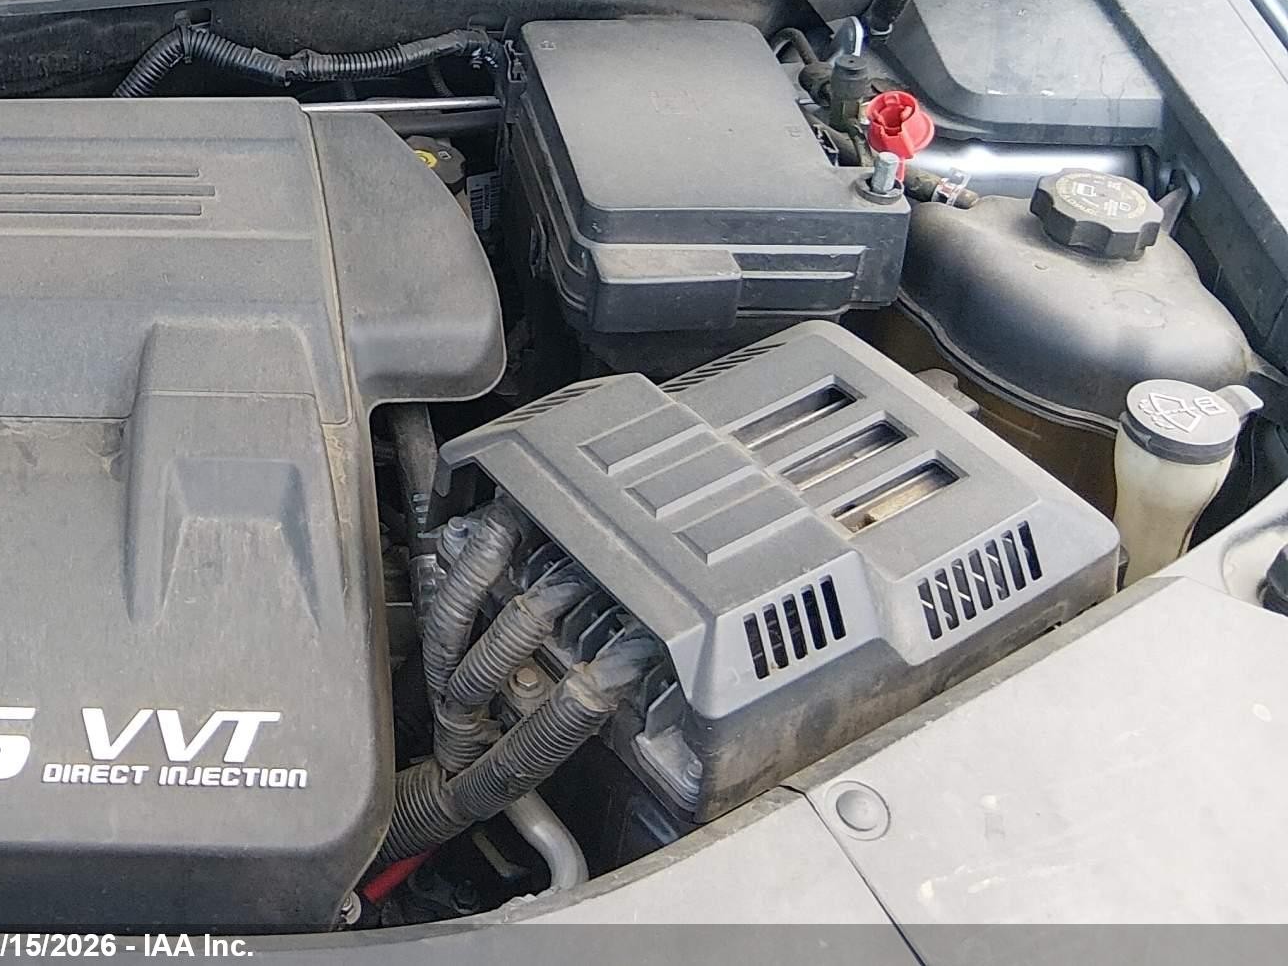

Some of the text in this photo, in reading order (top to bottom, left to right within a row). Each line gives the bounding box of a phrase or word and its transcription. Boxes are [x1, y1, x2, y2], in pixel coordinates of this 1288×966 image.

[82, 707, 282, 763] VVT
[42, 763, 308, 788] DIRECT INJECTION
